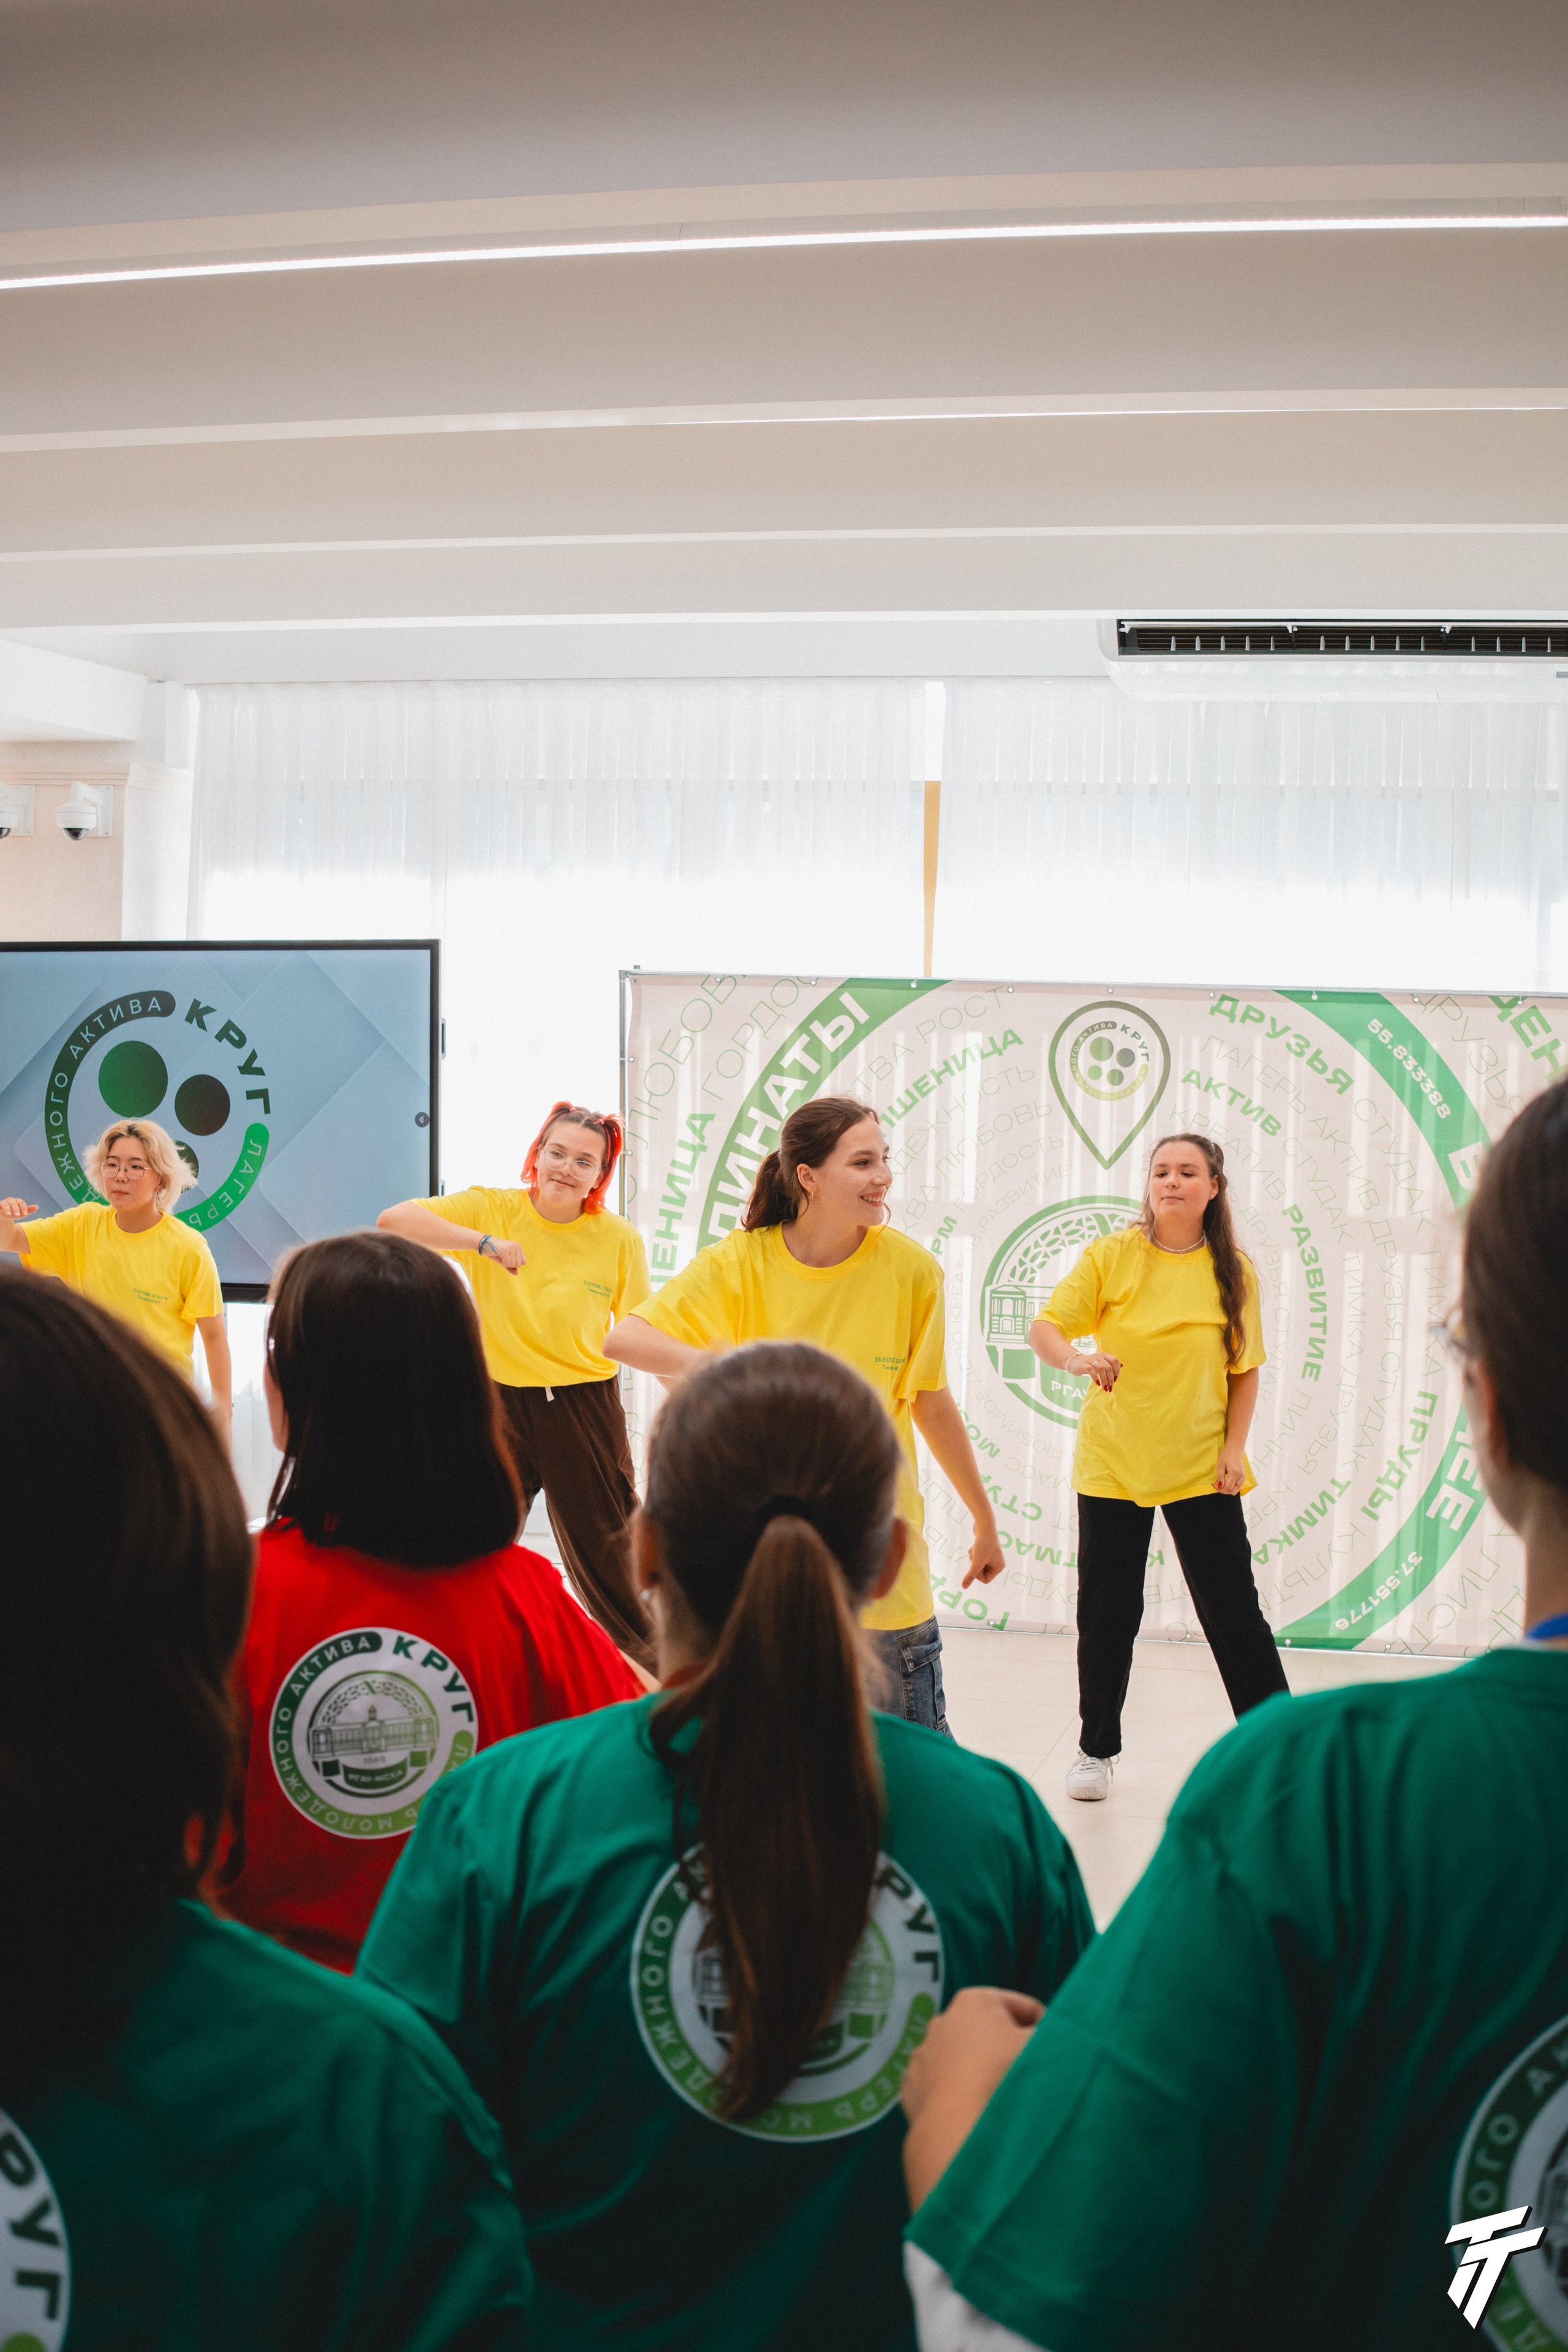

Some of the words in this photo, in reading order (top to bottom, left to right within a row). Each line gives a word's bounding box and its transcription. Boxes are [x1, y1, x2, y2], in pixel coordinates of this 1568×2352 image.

[69, 996, 162, 1061] АКТИВА
[184, 998, 271, 1115] КРУГ
[628, 974, 747, 1150] ЛЮБОВ
[702, 976, 821, 1101] ГОРДО
[916, 986, 1003, 1044] РОСТ
[1079, 1022, 1113, 1042] АКТИВА
[1120, 1023, 1149, 1061] КРУГ
[1209, 993, 1354, 1096] ДРУЗЬЯ
[1368, 1018, 1452, 1119] 55.833388
[707, 992, 870, 1238] ДИНАТЫ
[1181, 1069, 1281, 1136] АКТИВ
[1199, 1035, 1306, 1114] ЛАГЕРЬ
[888, 1066, 1035, 1193] АДЕЖНОСТЬ
[935, 1101, 1052, 1181] ЛЮБОВЬ
[1308, 1117, 1381, 1210] АКТИВ
[1354, 1098, 1436, 1234] СТУДАК
[188, 1138, 263, 1229] ЛАГЕРЬ
[650, 1114, 715, 1294] ЕНИЦА
[979, 1164, 1070, 1232] РАЗВИТИЕ
[1283, 1137, 1354, 1244] СТУДАК
[1237, 1207, 1288, 1297] ДРУЗЬЯ
[1282, 1204, 1328, 1382] РАЗВИТИЕ
[1343, 1249, 1366, 1359] ТИМКА
[1364, 1220, 1404, 1341] ДРУЗЬЯ
[1297, 1366, 1359, 1476] ДРУЗЬЯ
[1342, 1352, 1401, 1472] СТУДАК
[1360, 1390, 1438, 1521] ПРУДЫ
[1251, 1477, 1352, 1565] ТИМКА
[1003, 1570, 1078, 1605] РУДЫ
[1335, 1551, 1423, 1630] 37.551776
[290, 1635, 371, 1697] АКТИВА
[393, 1635, 475, 1723] КРУГ
[276, 1707, 393, 1832] МОЛОДЕЖНОГО
[875, 1864, 940, 1983] РУГ
[0, 2132, 60, 2320] РУГ
